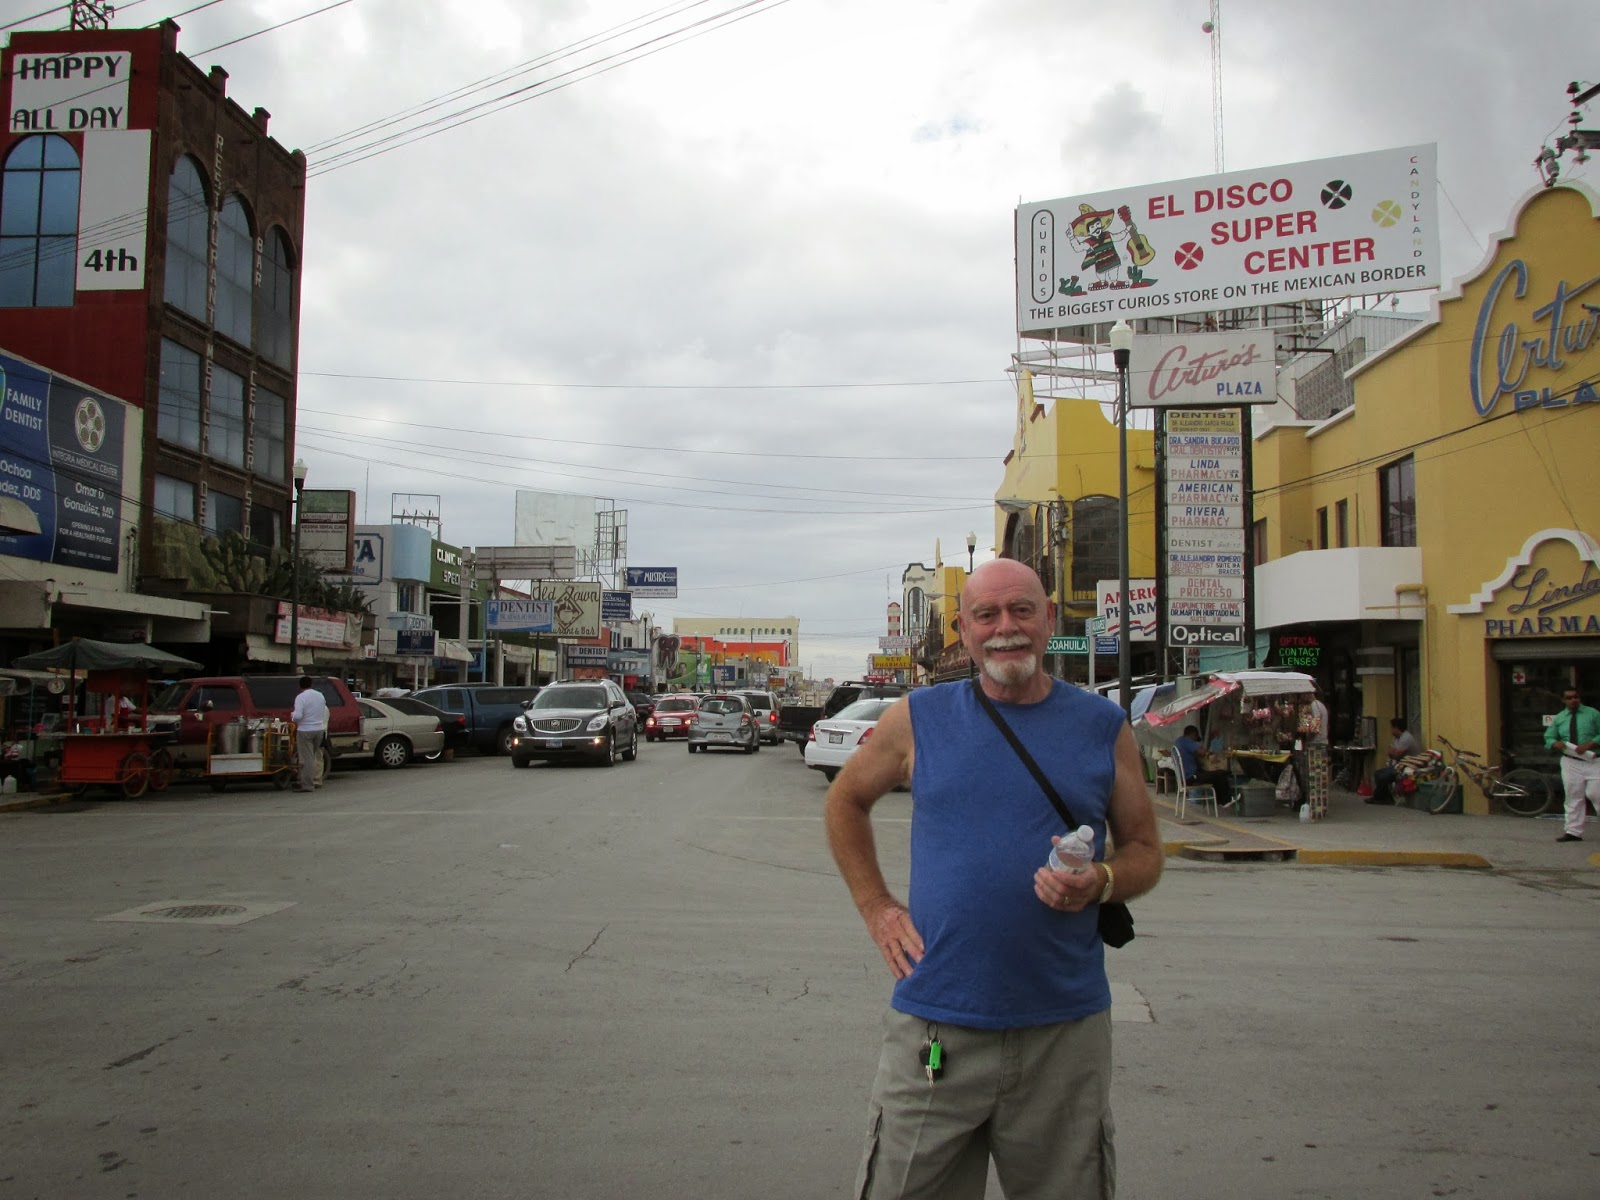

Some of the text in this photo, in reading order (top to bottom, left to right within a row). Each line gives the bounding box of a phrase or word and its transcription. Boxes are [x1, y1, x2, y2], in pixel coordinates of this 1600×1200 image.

[20, 55, 122, 80] HAPPY
[13, 106, 123, 130] ALL DAY
[1148, 178, 1293, 220] EL DISCO
[1210, 210, 1317, 246] SUPER
[84, 248, 138, 272] 4th
[255, 236, 264, 288] BAR
[1039, 217, 1047, 296] CURIOS
[1244, 237, 1375, 275] CENTER
[1029, 263, 1427, 320] THE BIGGEST CURIOS STORE ON THE MEXICAN BORDER
[1148, 343, 1261, 401] Arturo's
[1216, 380, 1262, 397] PLAZA
[6, 387, 42, 412] FAMILY
[5, 407, 42, 432] DENTIST
[1169, 411, 1237, 419] DENTIST
[1184, 436, 1209, 446] SANDRA
[1190, 460, 1220, 469] LINDA
[1171, 469, 1229, 479] PHARMACY
[23, 485, 41, 501] DDS
[75, 482, 98, 498] Omar
[1178, 483, 1233, 493] AMERICAN
[1171, 493, 1229, 503] PHARMACY
[102, 505, 115, 519] MD
[1185, 506, 1225, 516] RIVERA
[1171, 516, 1230, 527] PHARMACY
[1171, 539, 1213, 547] DENTIST
[436, 548, 456, 566] CLINIC
[1187, 578, 1224, 588] DENTAL
[1180, 587, 1232, 598] PROGRESO
[500, 601, 550, 613] DENTIST
[1172, 625, 1240, 645] Optical
[1279, 636, 1319, 646] OPTICAL
[579, 647, 607, 655] DENTIST
[1047, 640, 1088, 652] COAHUILA
[1278, 647, 1321, 657] CONTACT
[1281, 657, 1318, 666] LENSES
